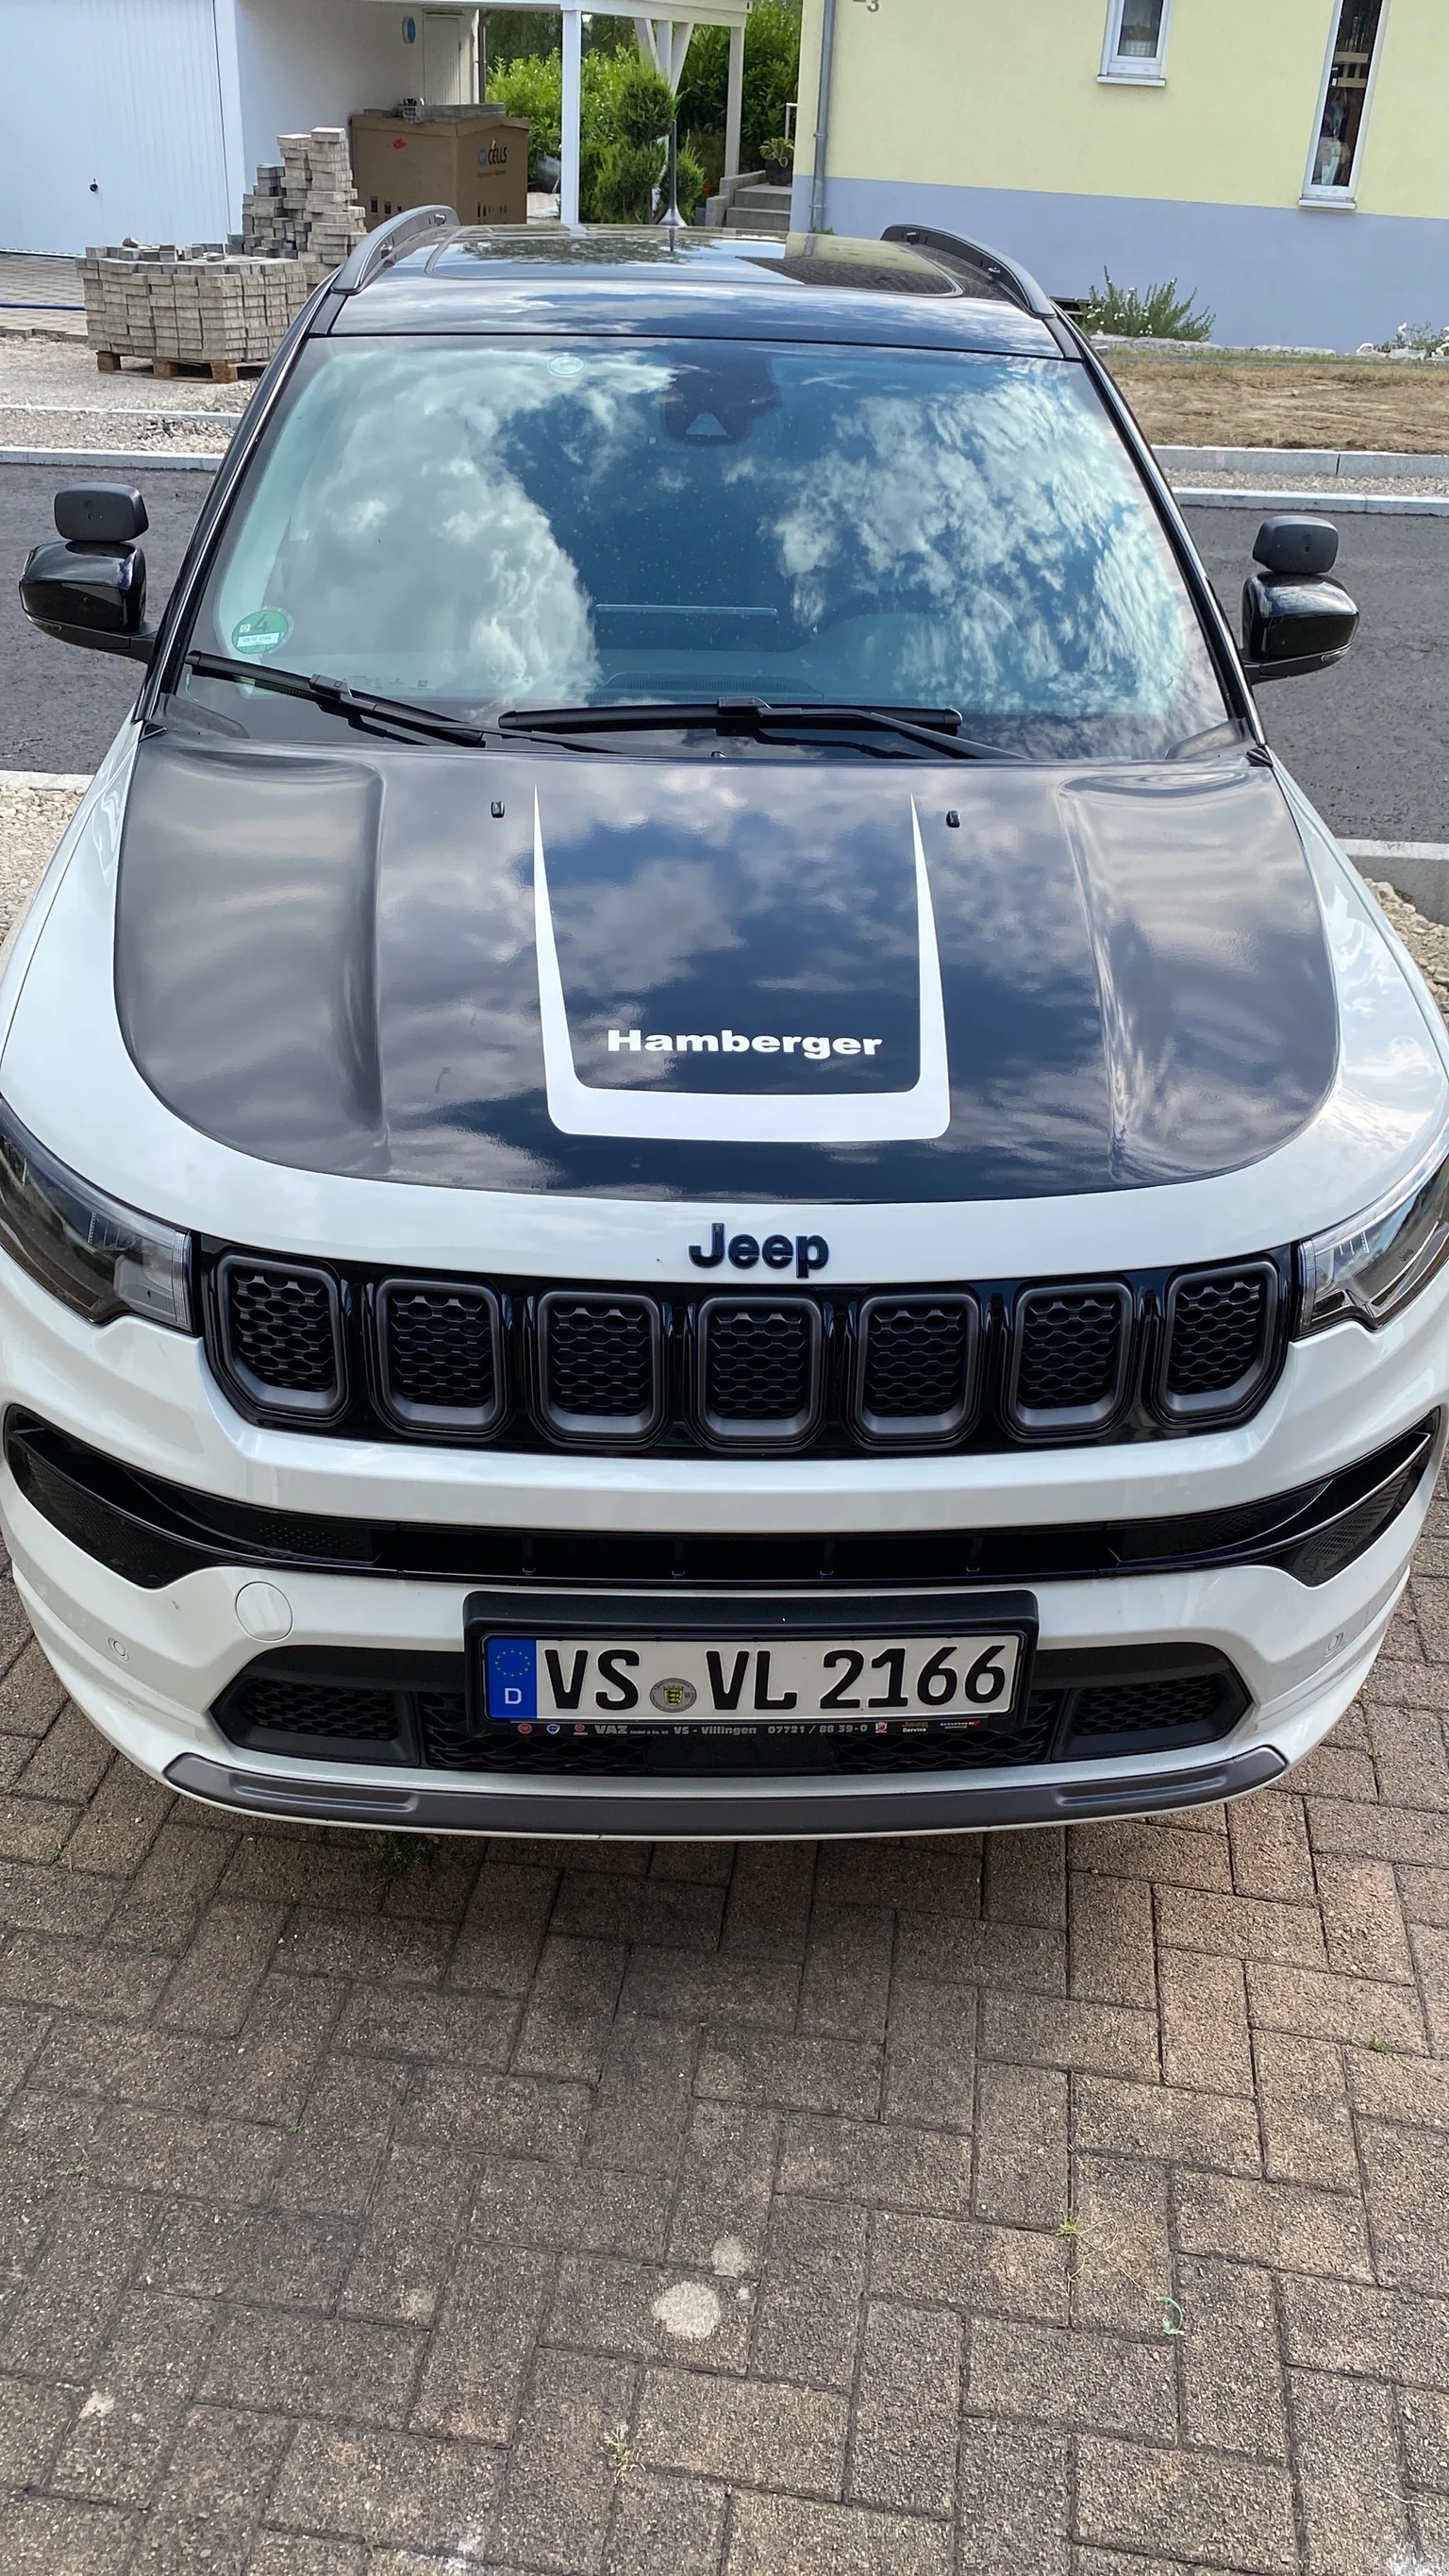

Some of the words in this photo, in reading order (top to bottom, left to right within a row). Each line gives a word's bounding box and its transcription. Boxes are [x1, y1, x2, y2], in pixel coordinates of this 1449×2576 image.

[254, 613, 268, 631] 4
[608, 1029, 882, 1059] Hamberger
[689, 1223, 829, 1279] Jeep
[544, 1648, 640, 1710] VS
[706, 1650, 797, 1710] VL
[820, 1646, 1006, 1709] 2166
[505, 1687, 522, 1704] D
[594, 1725, 627, 1734] VAZ
[673, 1726, 689, 1734] VS
[701, 1726, 758, 1735] Villingen
[767, 1725, 805, 1733] 07721
[819, 1725, 835, 1733] 88
